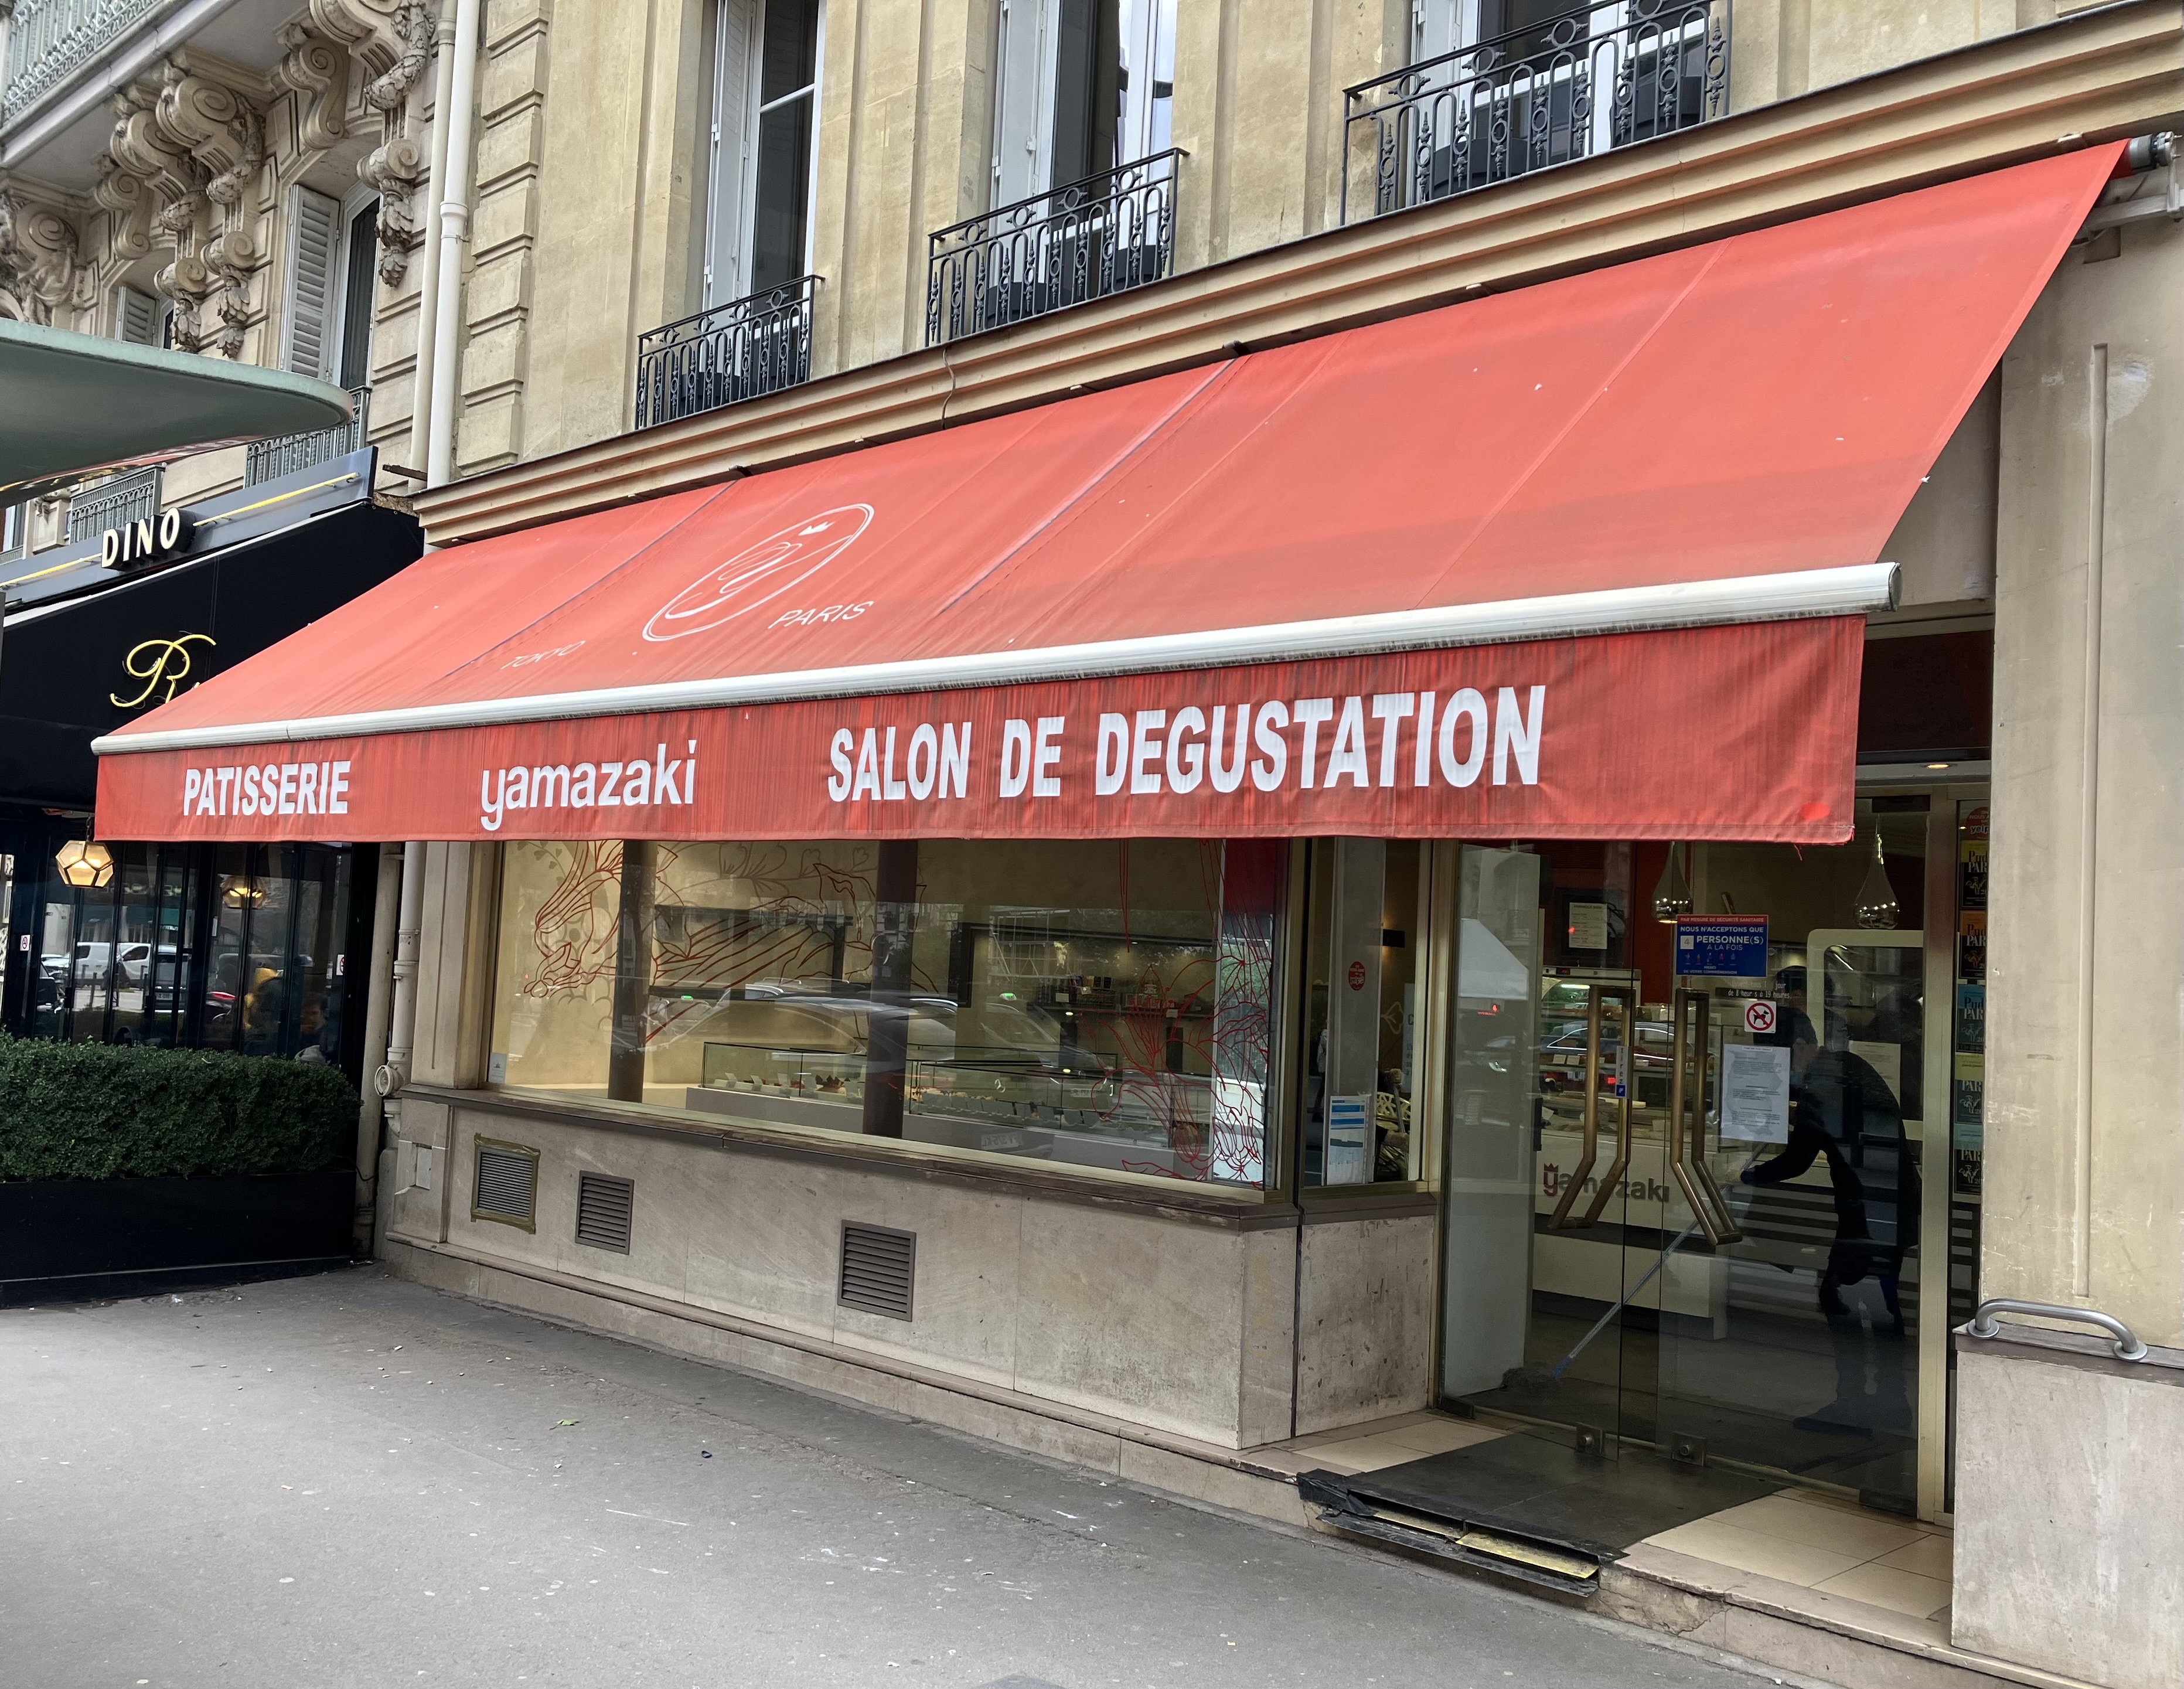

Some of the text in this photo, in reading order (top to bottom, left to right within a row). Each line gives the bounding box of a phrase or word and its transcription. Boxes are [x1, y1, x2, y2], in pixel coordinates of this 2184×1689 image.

[101, 507, 180, 567] DINO
[768, 601, 874, 629] PARIS
[500, 640, 586, 670] TOKYO
[828, 685, 1546, 802] SALON DE DEGUSTATION
[183, 760, 351, 816] PATISSERIE
[481, 739, 697, 831] yamazaki
[1696, 936, 1764, 945] PERSONNE(S)
